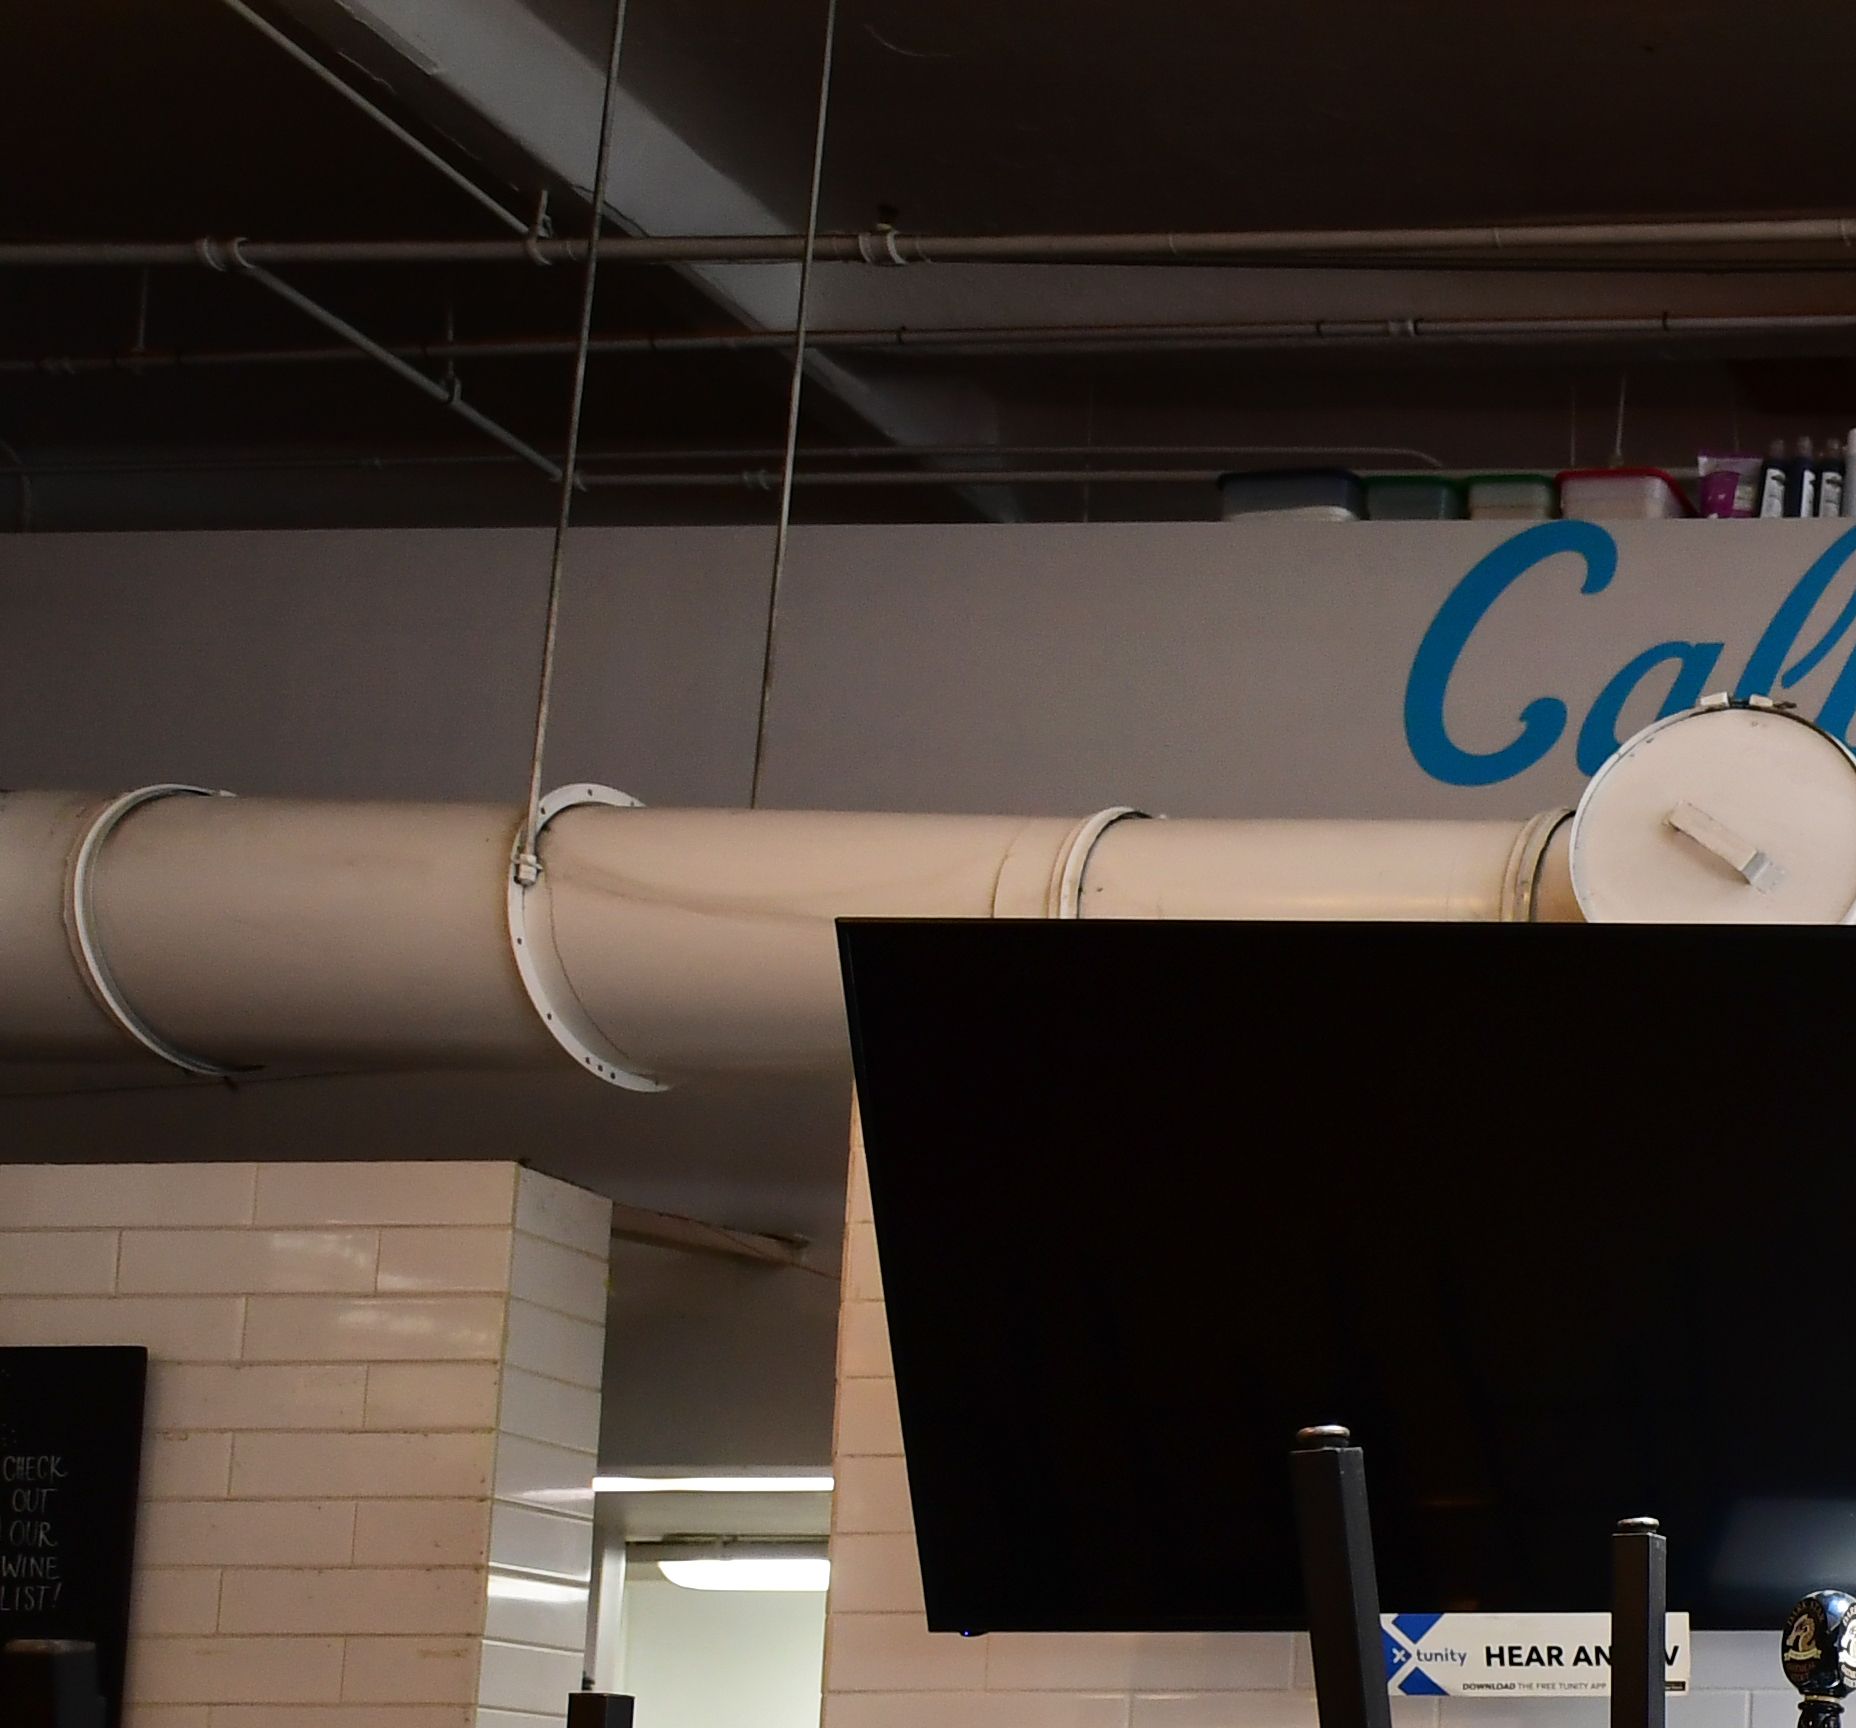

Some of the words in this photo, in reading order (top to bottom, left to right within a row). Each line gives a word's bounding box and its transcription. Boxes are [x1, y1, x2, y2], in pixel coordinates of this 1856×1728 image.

[3, 1455, 68, 1482] CHECK
[12, 1488, 58, 1513] OUT
[9, 1521, 58, 1547] OUR
[1, 1553, 61, 1580] WINE
[1416, 1647, 1468, 1665] tunity
[1485, 1646, 1565, 1667] HEAR
[1573, 1646, 1611, 1667] AN
[1462, 1682, 1516, 1690] DOWNLOAD
